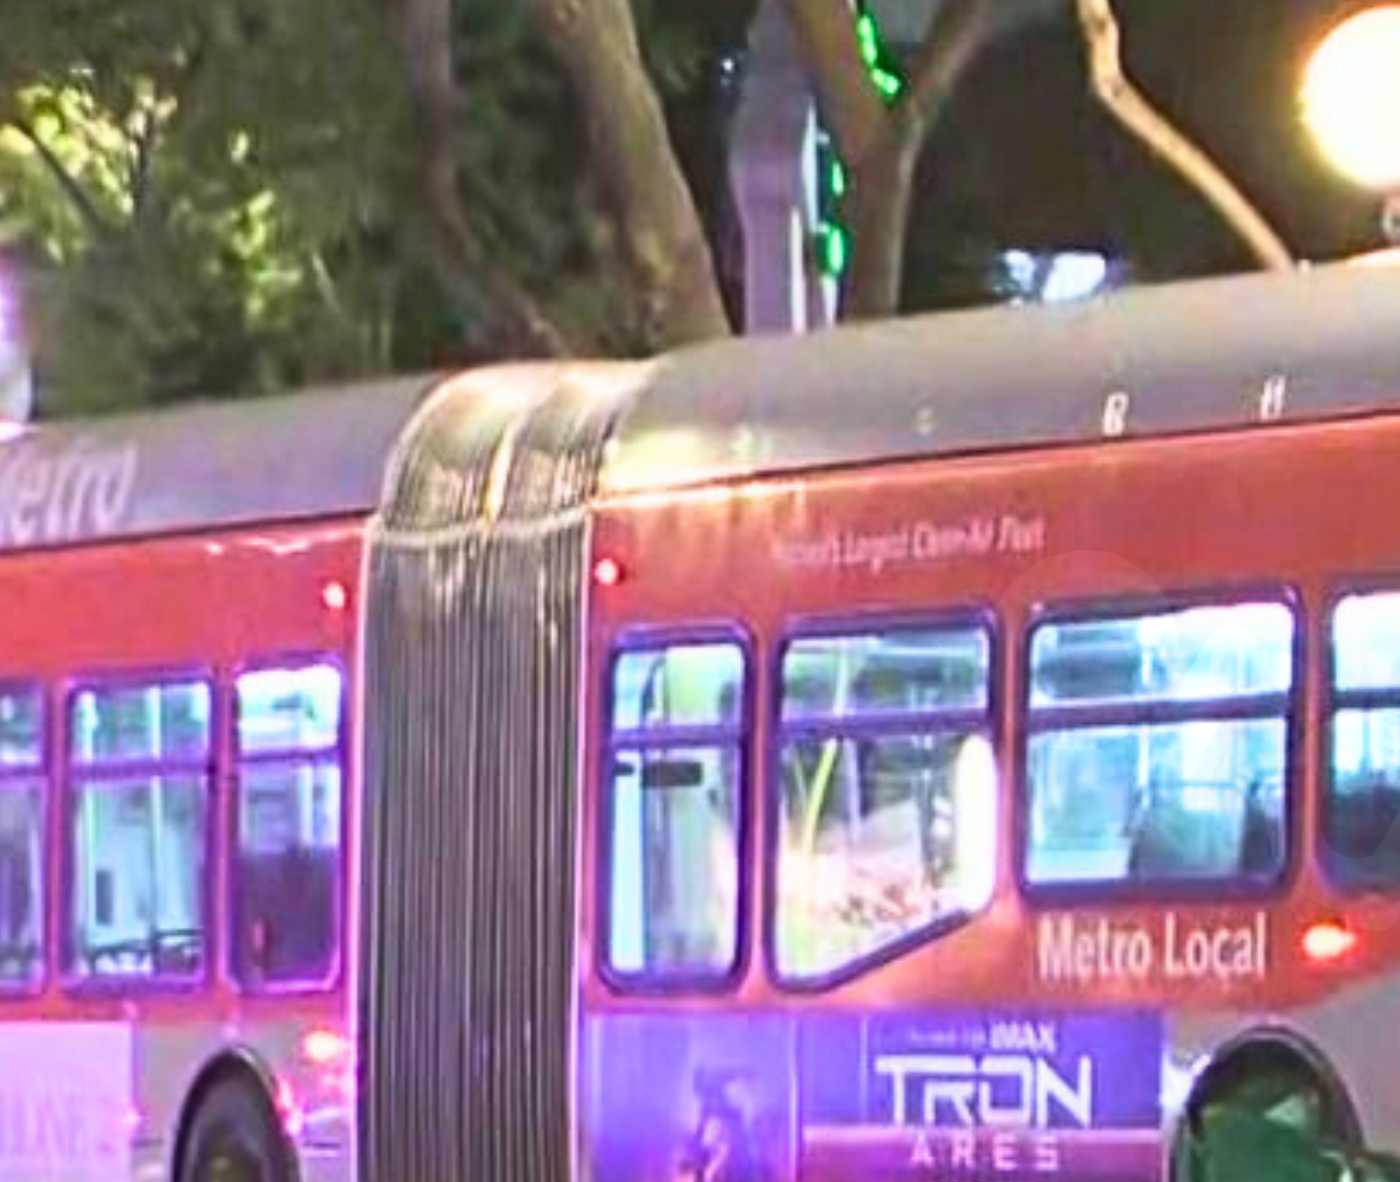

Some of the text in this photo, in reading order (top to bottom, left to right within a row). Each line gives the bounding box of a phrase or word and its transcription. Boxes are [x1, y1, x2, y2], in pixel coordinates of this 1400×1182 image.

[1037, 910, 1268, 982] Metro Local
[989, 1020, 1058, 1053] IMAX
[872, 1052, 1094, 1130] TRON
[909, 1130, 1062, 1171] ARES
